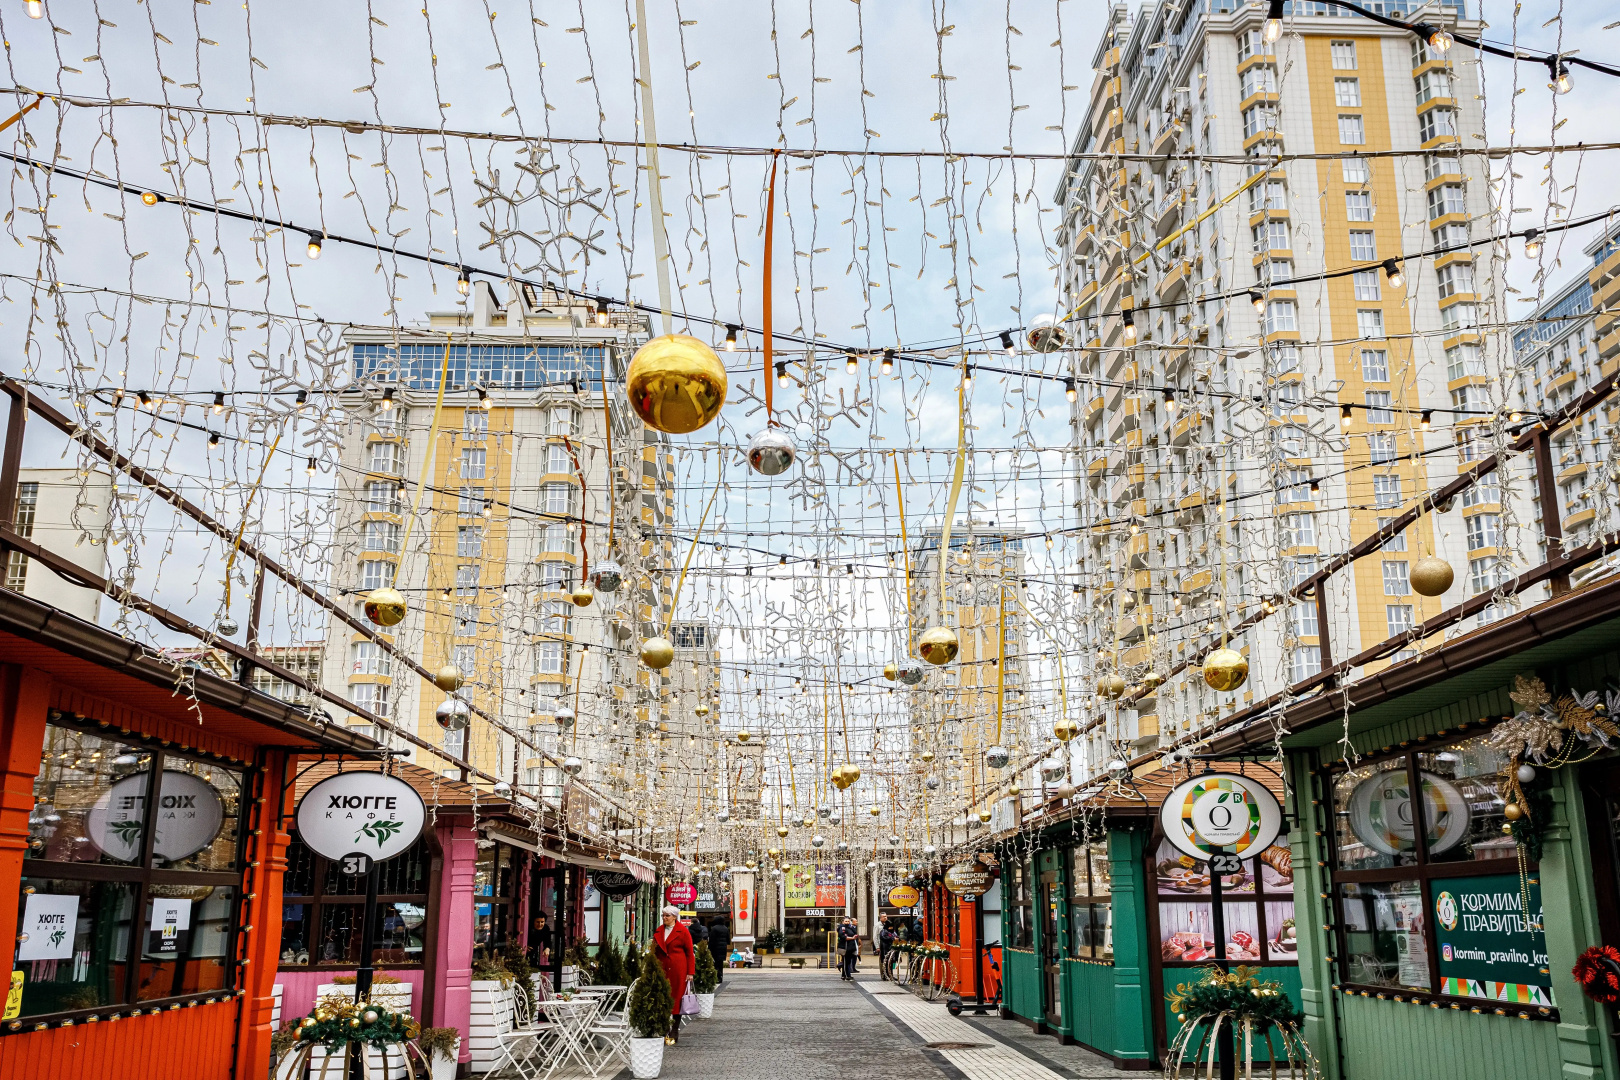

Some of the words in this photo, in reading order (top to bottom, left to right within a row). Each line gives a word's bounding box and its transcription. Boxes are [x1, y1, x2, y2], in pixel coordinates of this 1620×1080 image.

[328, 795, 397, 809] ХЮГГЕ
[326, 812, 396, 820] КАФЕ
[343, 857, 366, 874] 31
[1213, 855, 1239, 871] 23
[1460, 893, 1523, 912] КОРМИМ
[38, 914, 65, 924] ХЮГГЕ
